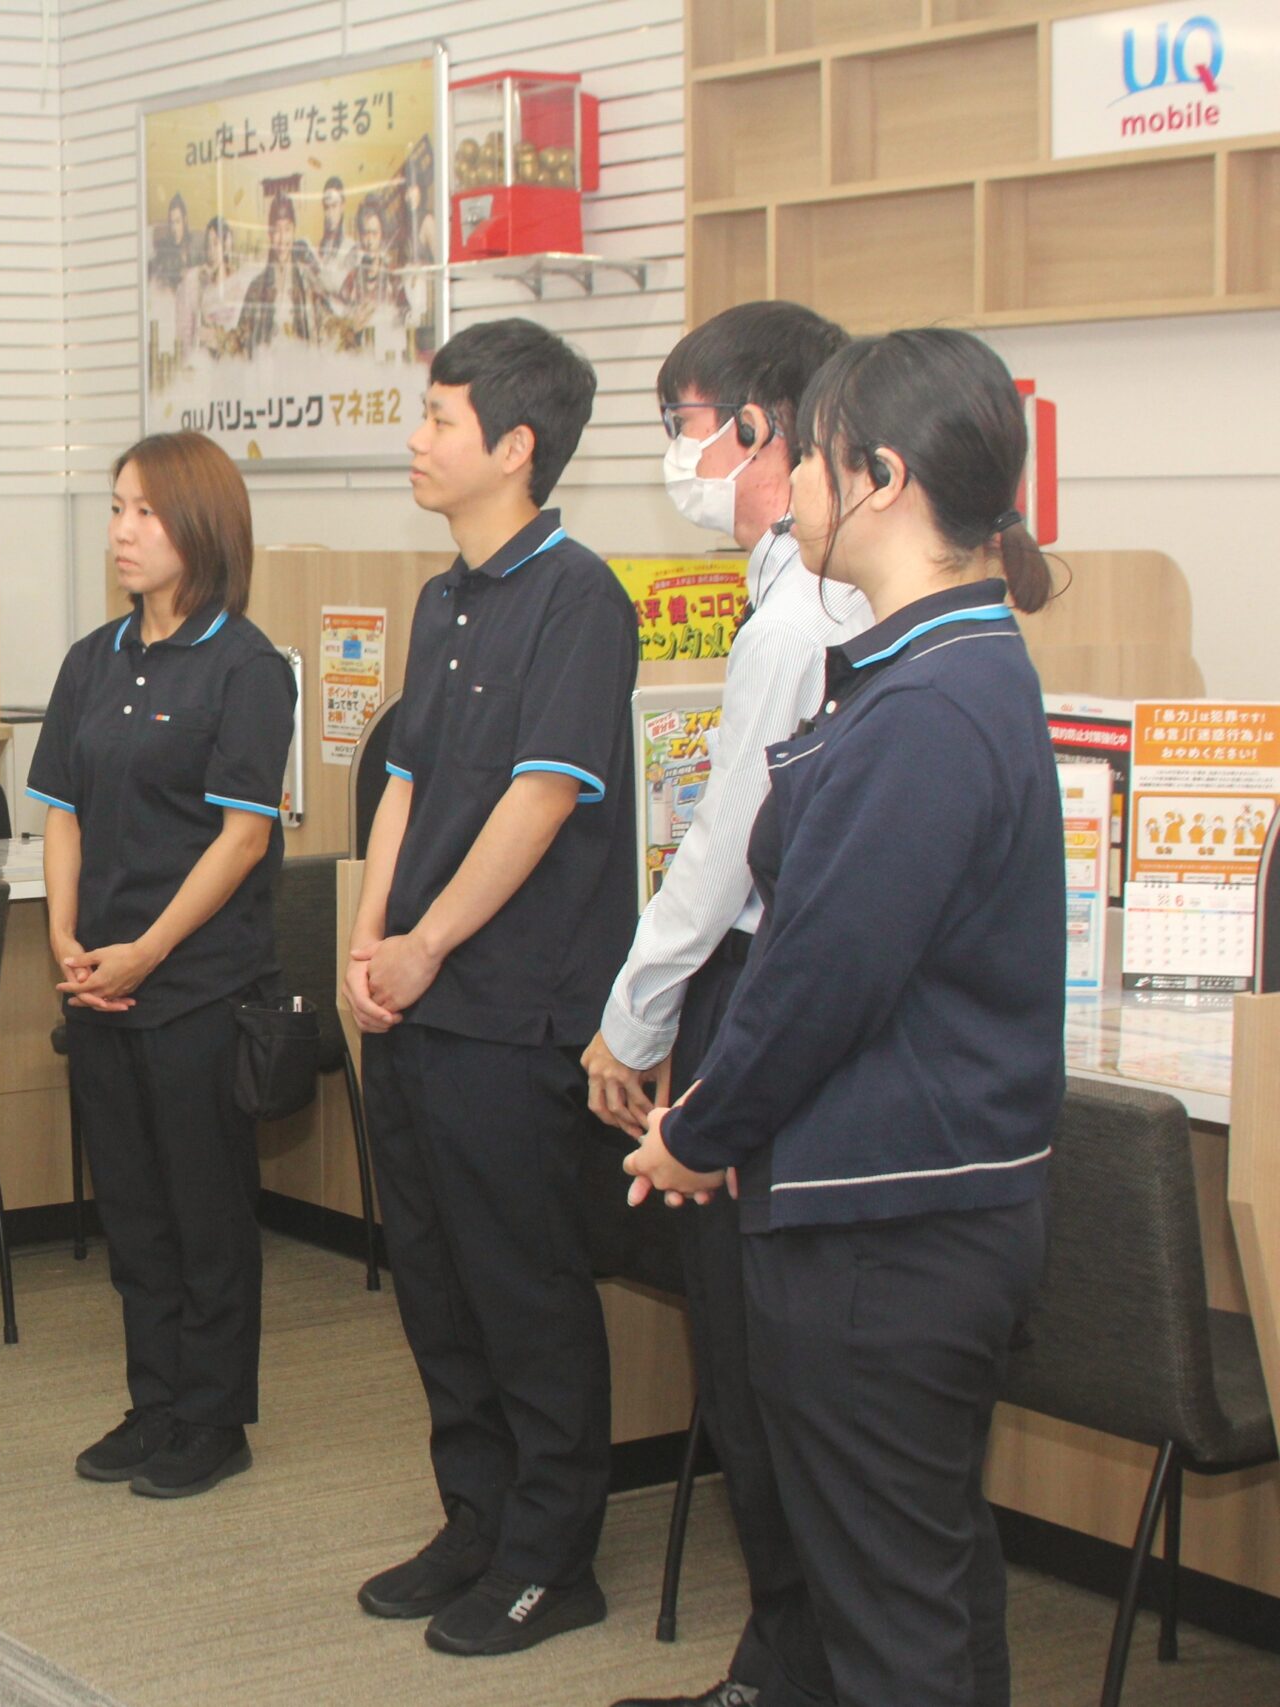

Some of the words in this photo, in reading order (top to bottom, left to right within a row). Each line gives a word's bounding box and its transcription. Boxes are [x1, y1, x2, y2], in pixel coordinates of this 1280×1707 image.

[1122, 14, 1224, 93] UQ
[1121, 101, 1220, 137] mobile
[329, 387, 402, 427] マネ活2
[1174, 895, 1184, 907] 6
